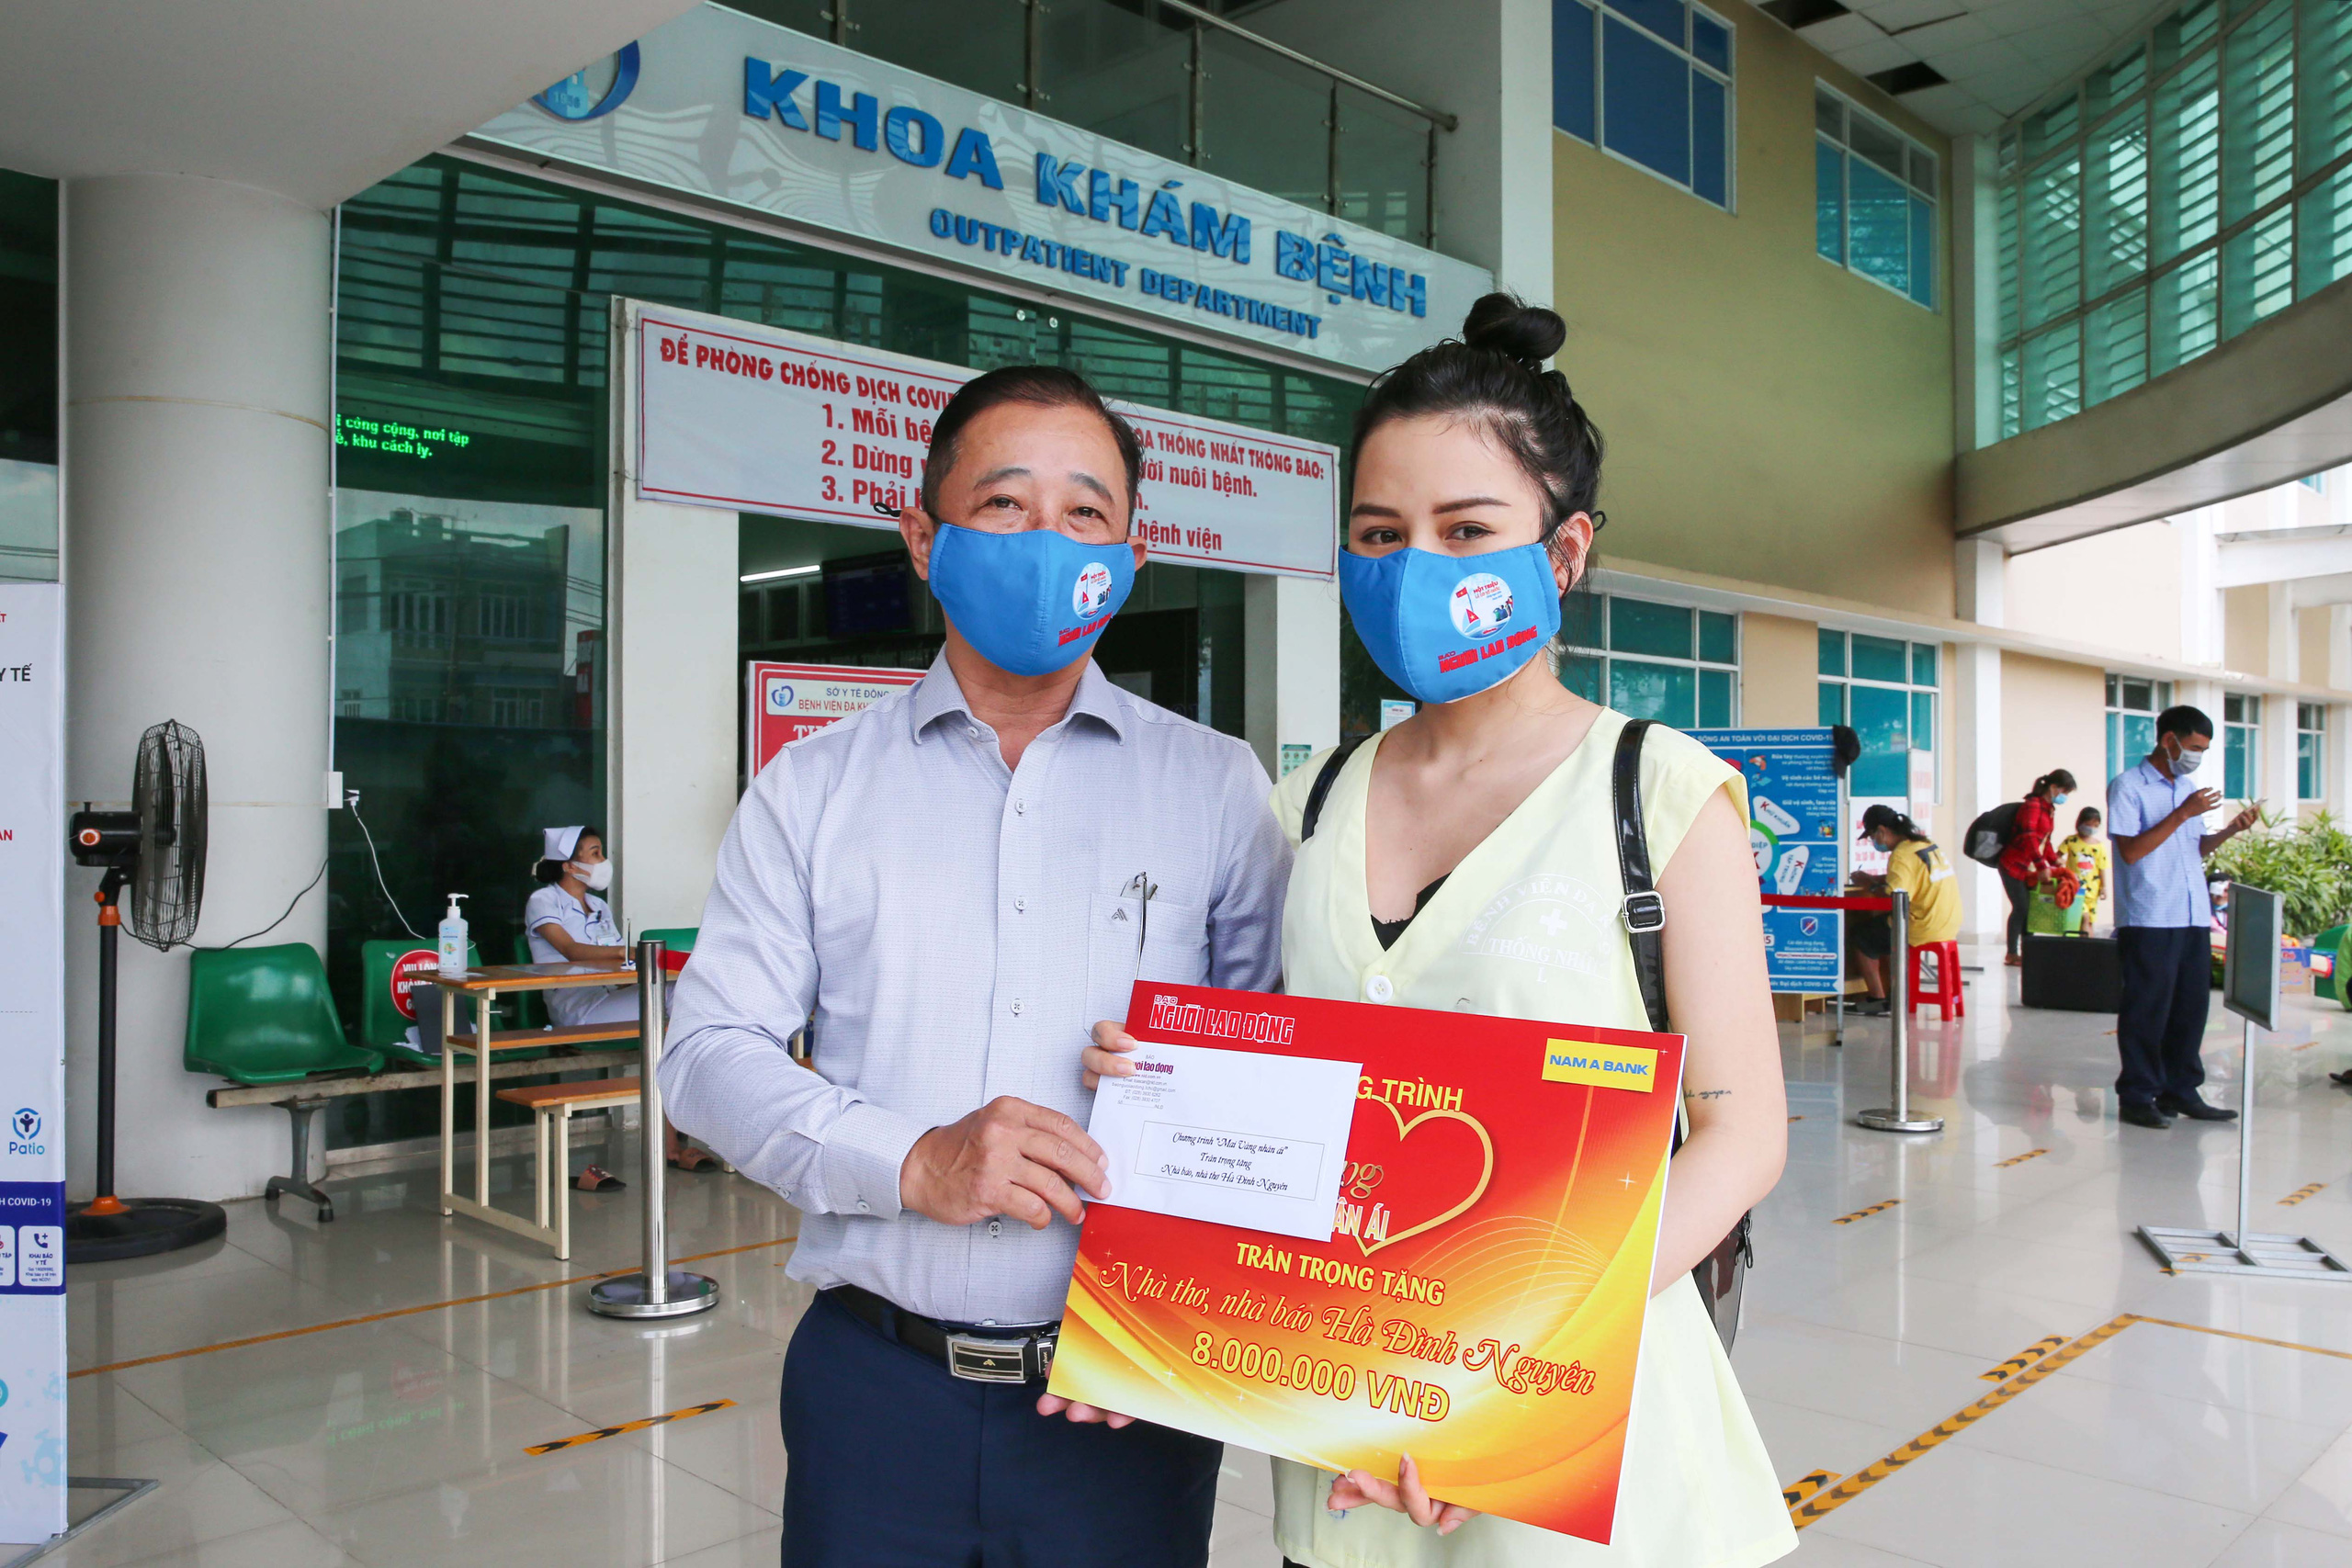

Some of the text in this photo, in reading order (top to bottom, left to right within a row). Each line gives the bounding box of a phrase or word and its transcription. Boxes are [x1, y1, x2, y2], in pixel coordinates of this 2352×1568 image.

[745, 56, 1427, 318] KHOA KHÁM BỆNH
[930, 209, 1322, 339] OUTPATIENT DEPARTMENT
[661, 333, 689, 366] ĐỂ
[695, 345, 774, 381] PHÒNG
[781, 359, 851, 395] CHỐNG
[856, 376, 901, 406] DỊCH
[345, 416, 379, 434] công
[383, 423, 420, 440] cộng,
[424, 429, 446, 441] nơi
[448, 432, 469, 447] tập
[822, 403, 932, 449] 1. Mỗi bệ
[353, 434, 378, 448] khu
[381, 440, 413, 454] cách
[821, 440, 844, 467] 2.
[853, 444, 912, 479] Dừng
[1158, 429, 1206, 458] THỐNG
[1211, 439, 1245, 465] NHẤT
[1249, 448, 1293, 475] THÔNG
[821, 476, 844, 502] 3.
[853, 479, 905, 509] Phải
[1170, 466, 1207, 489] nuôi
[1213, 467, 1258, 498] bệnh.
[1138, 519, 1222, 554] bệnh viện
[1480, 639, 1504, 660] LAO
[10, 662, 32, 682] TẾ
[798, 698, 821, 712] BỆNH
[823, 700, 842, 713] VIỆN
[844, 701, 855, 711] ĐA
[1517, 877, 1569, 897] VIỆN
[1488, 935, 1551, 962] THỐNG
[1149, 1004, 1295, 1044] NGƯỜI LAO ĐỘNG
[1550, 1055, 1648, 1077] NAM A BANK
[1381, 1077, 1464, 1111] TRÌNH
[9, 1142, 45, 1155] Patio
[1172, 1132, 1197, 1145] Chương
[1197, 1135, 1214, 1145] trình
[1238, 1140, 1258, 1154] Vàng
[1258, 1144, 1275, 1154] nhân
[1200, 1152, 1252, 1170] Trân trọng tặng
[1160, 1164, 1181, 1176] Nhà
[1195, 1169, 1208, 1179] nhà
[1208, 1171, 1220, 1180] thơ
[1221, 1172, 1235, 1183] Hà
[1236, 1175, 1255, 1186] Đình
[1256, 1179, 1287, 1191] Nguyên
[8, 1198, 51, 1206] COVID-19
[1363, 1202, 1390, 1241] ÁI
[1237, 1242, 1445, 1306] TRÂN TRỌNG TẶNG
[1099, 1260, 1597, 1396] Nhà thơ, nhà báo Hà Đình Nguyên
[1192, 1331, 1450, 1422] 8.000.000 VNĐ
